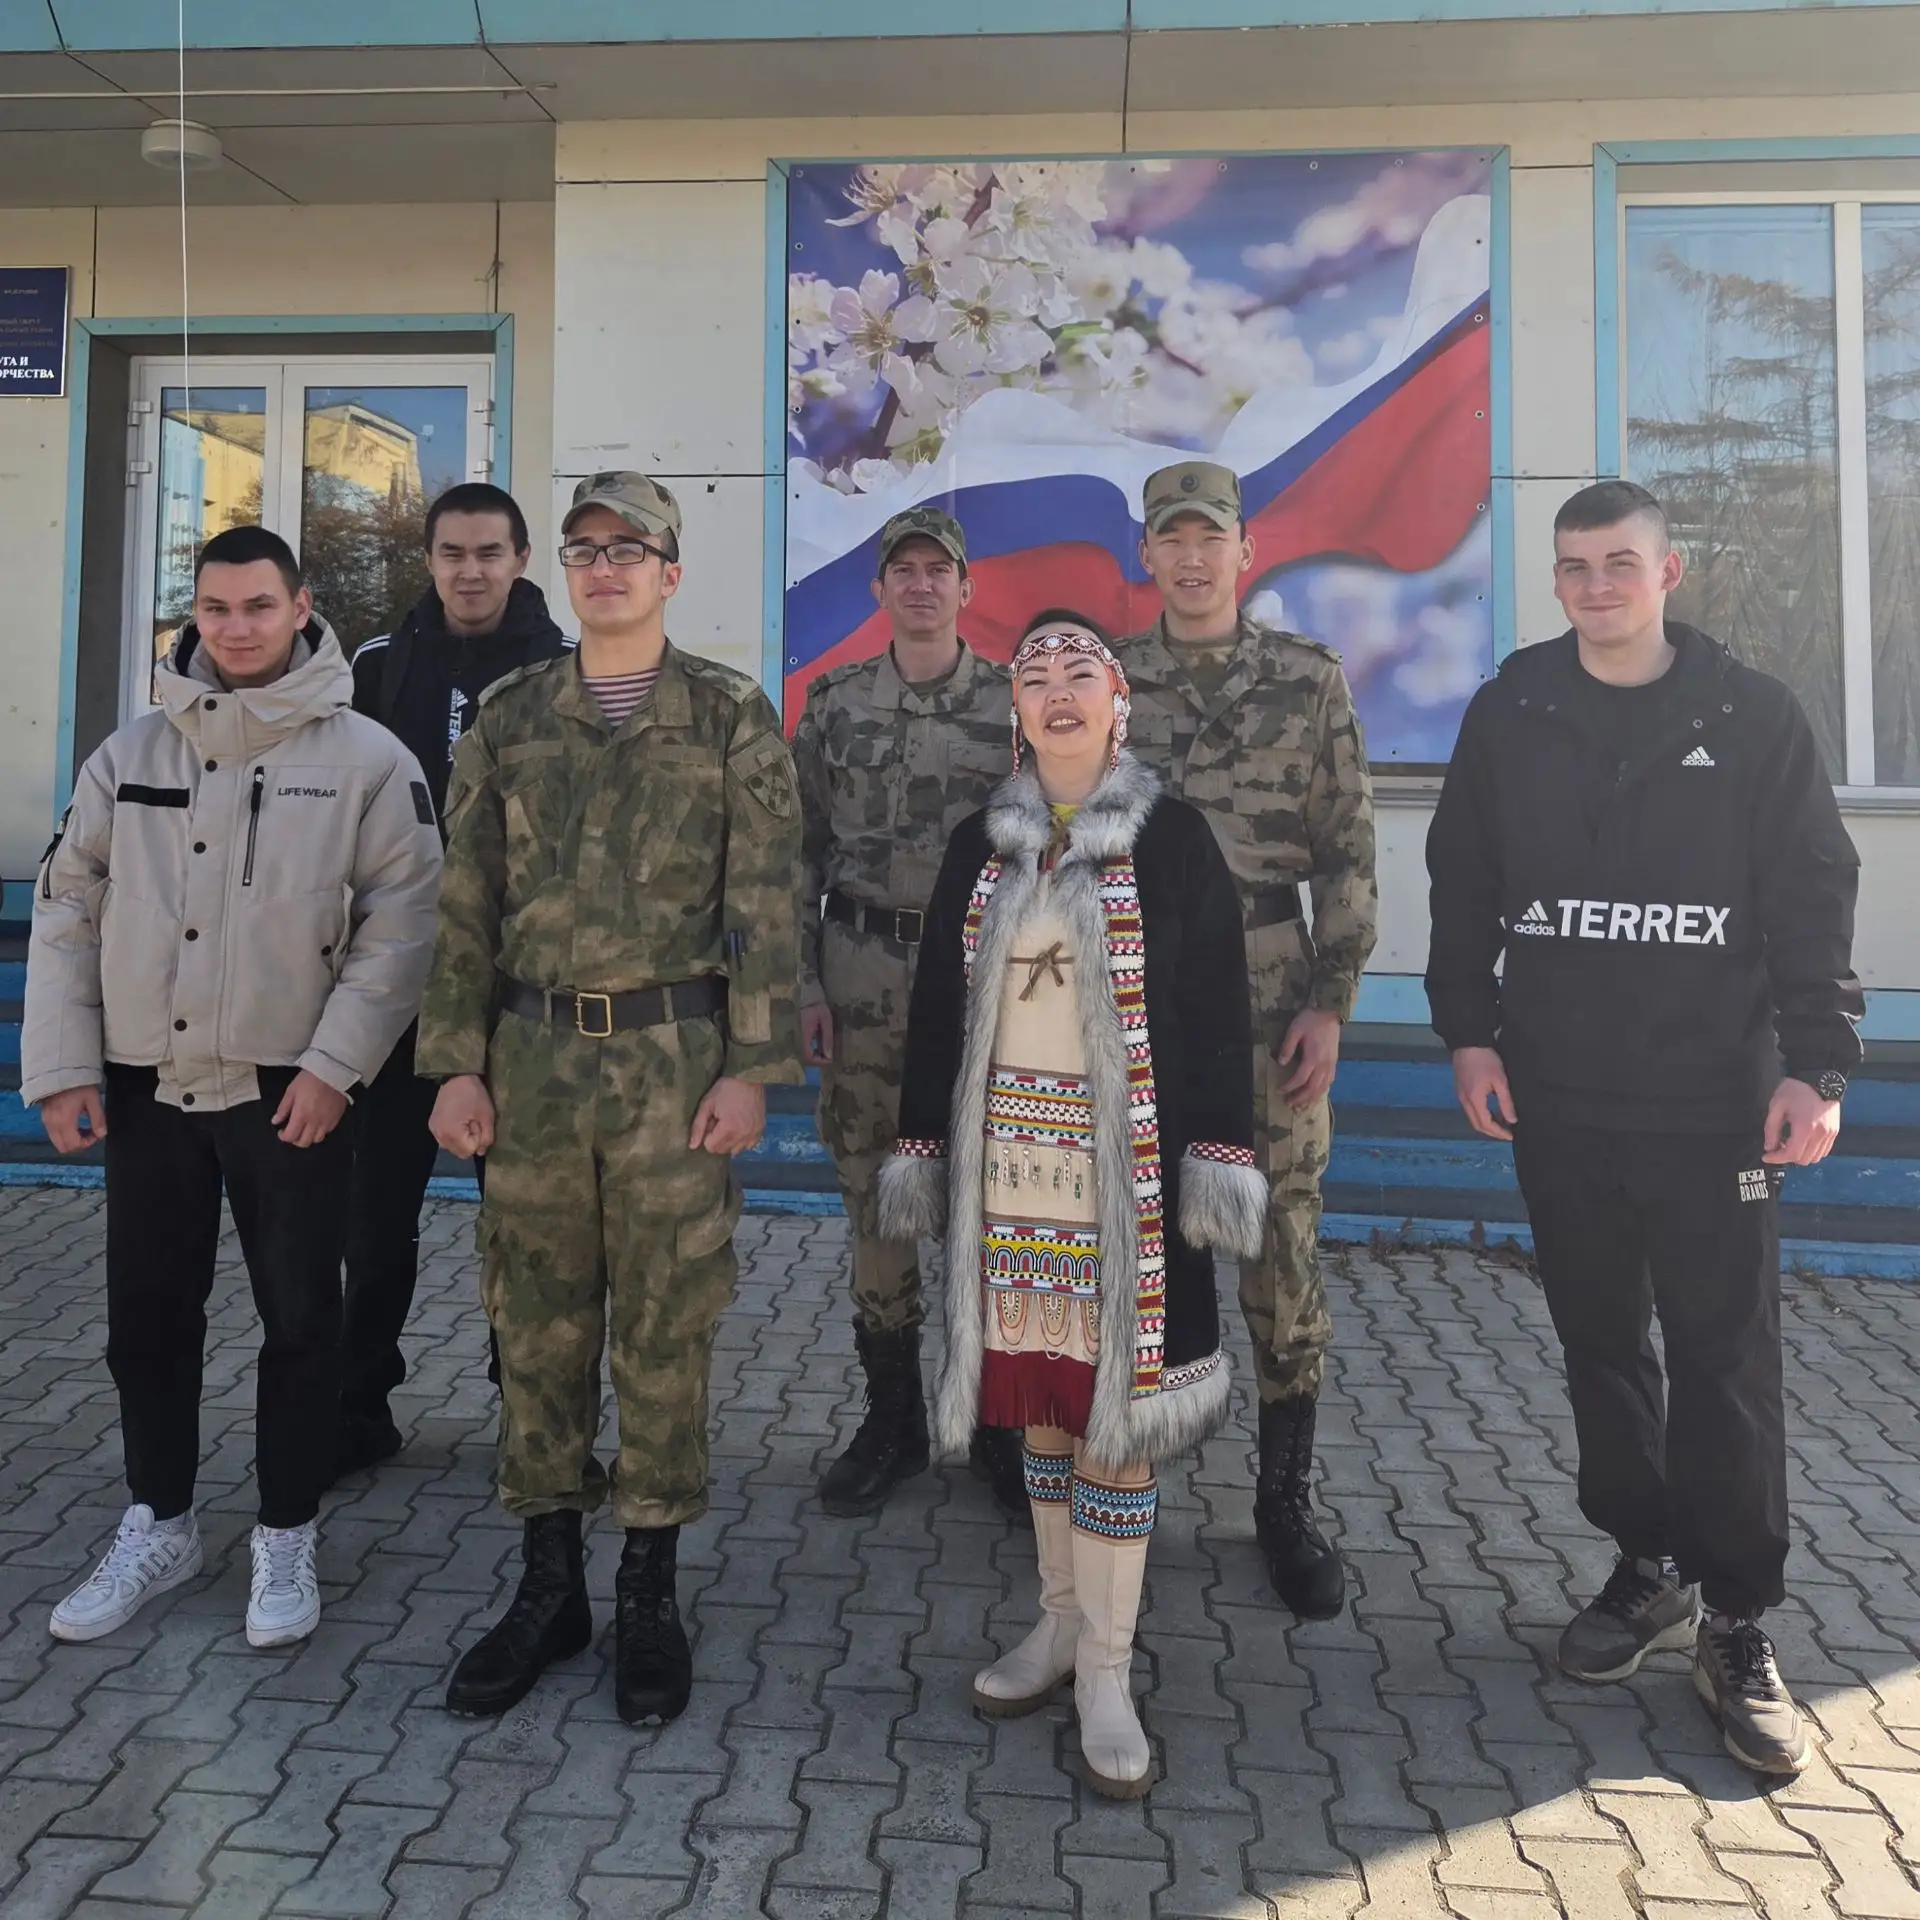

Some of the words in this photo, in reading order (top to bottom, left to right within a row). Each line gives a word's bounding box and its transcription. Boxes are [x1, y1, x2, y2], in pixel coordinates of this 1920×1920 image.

[19, 356, 29, 366] И
[1681, 759, 1716, 767] adidas
[1514, 923, 1556, 936] adidas
[1557, 899, 1731, 945] TERREX
